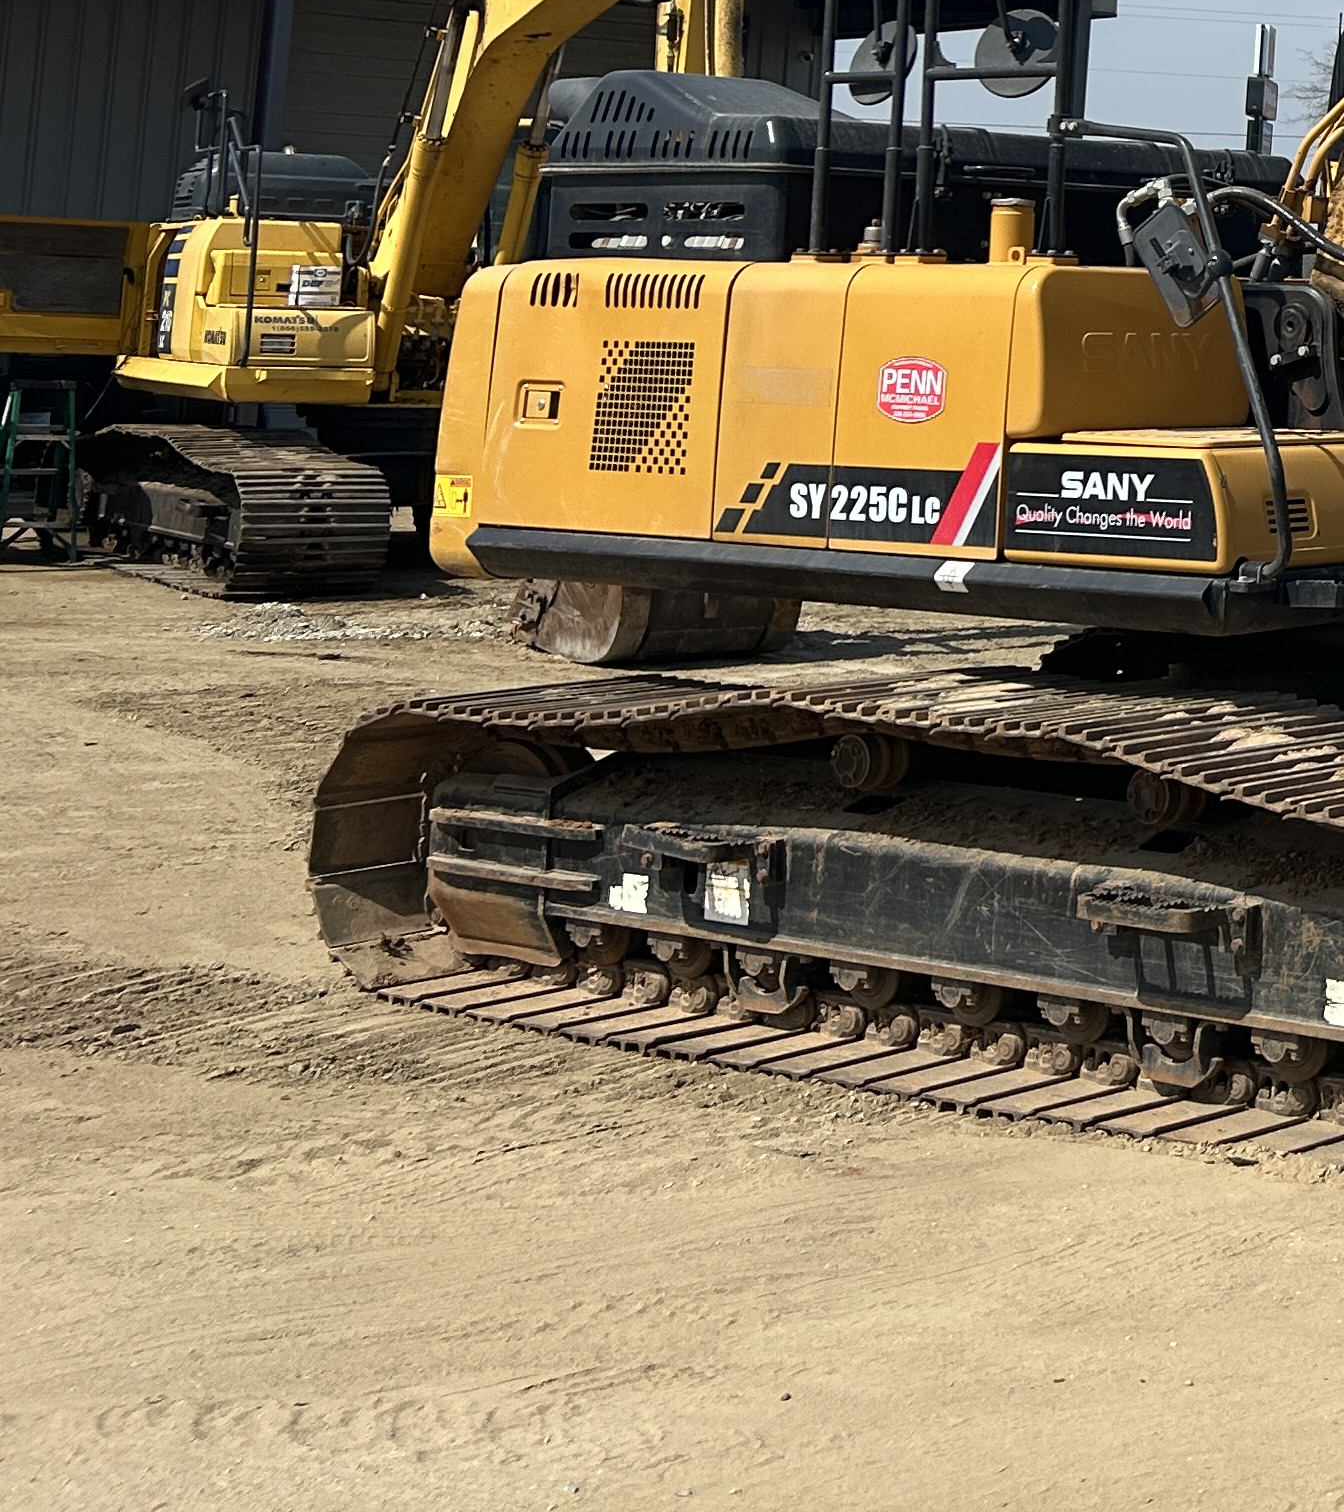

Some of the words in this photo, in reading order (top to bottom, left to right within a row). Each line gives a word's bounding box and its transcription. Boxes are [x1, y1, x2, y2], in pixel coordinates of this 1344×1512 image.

[254, 315, 315, 325] KOMATSU
[1082, 332, 1214, 373] SANY
[881, 368, 943, 396] PENN
[1060, 470, 1156, 502] SANY
[910, 495, 942, 525] LC
[1016, 503, 1064, 528] Quality
[1065, 505, 1123, 531] Changes
[1124, 508, 1147, 528] the
[1150, 509, 1193, 531] World
